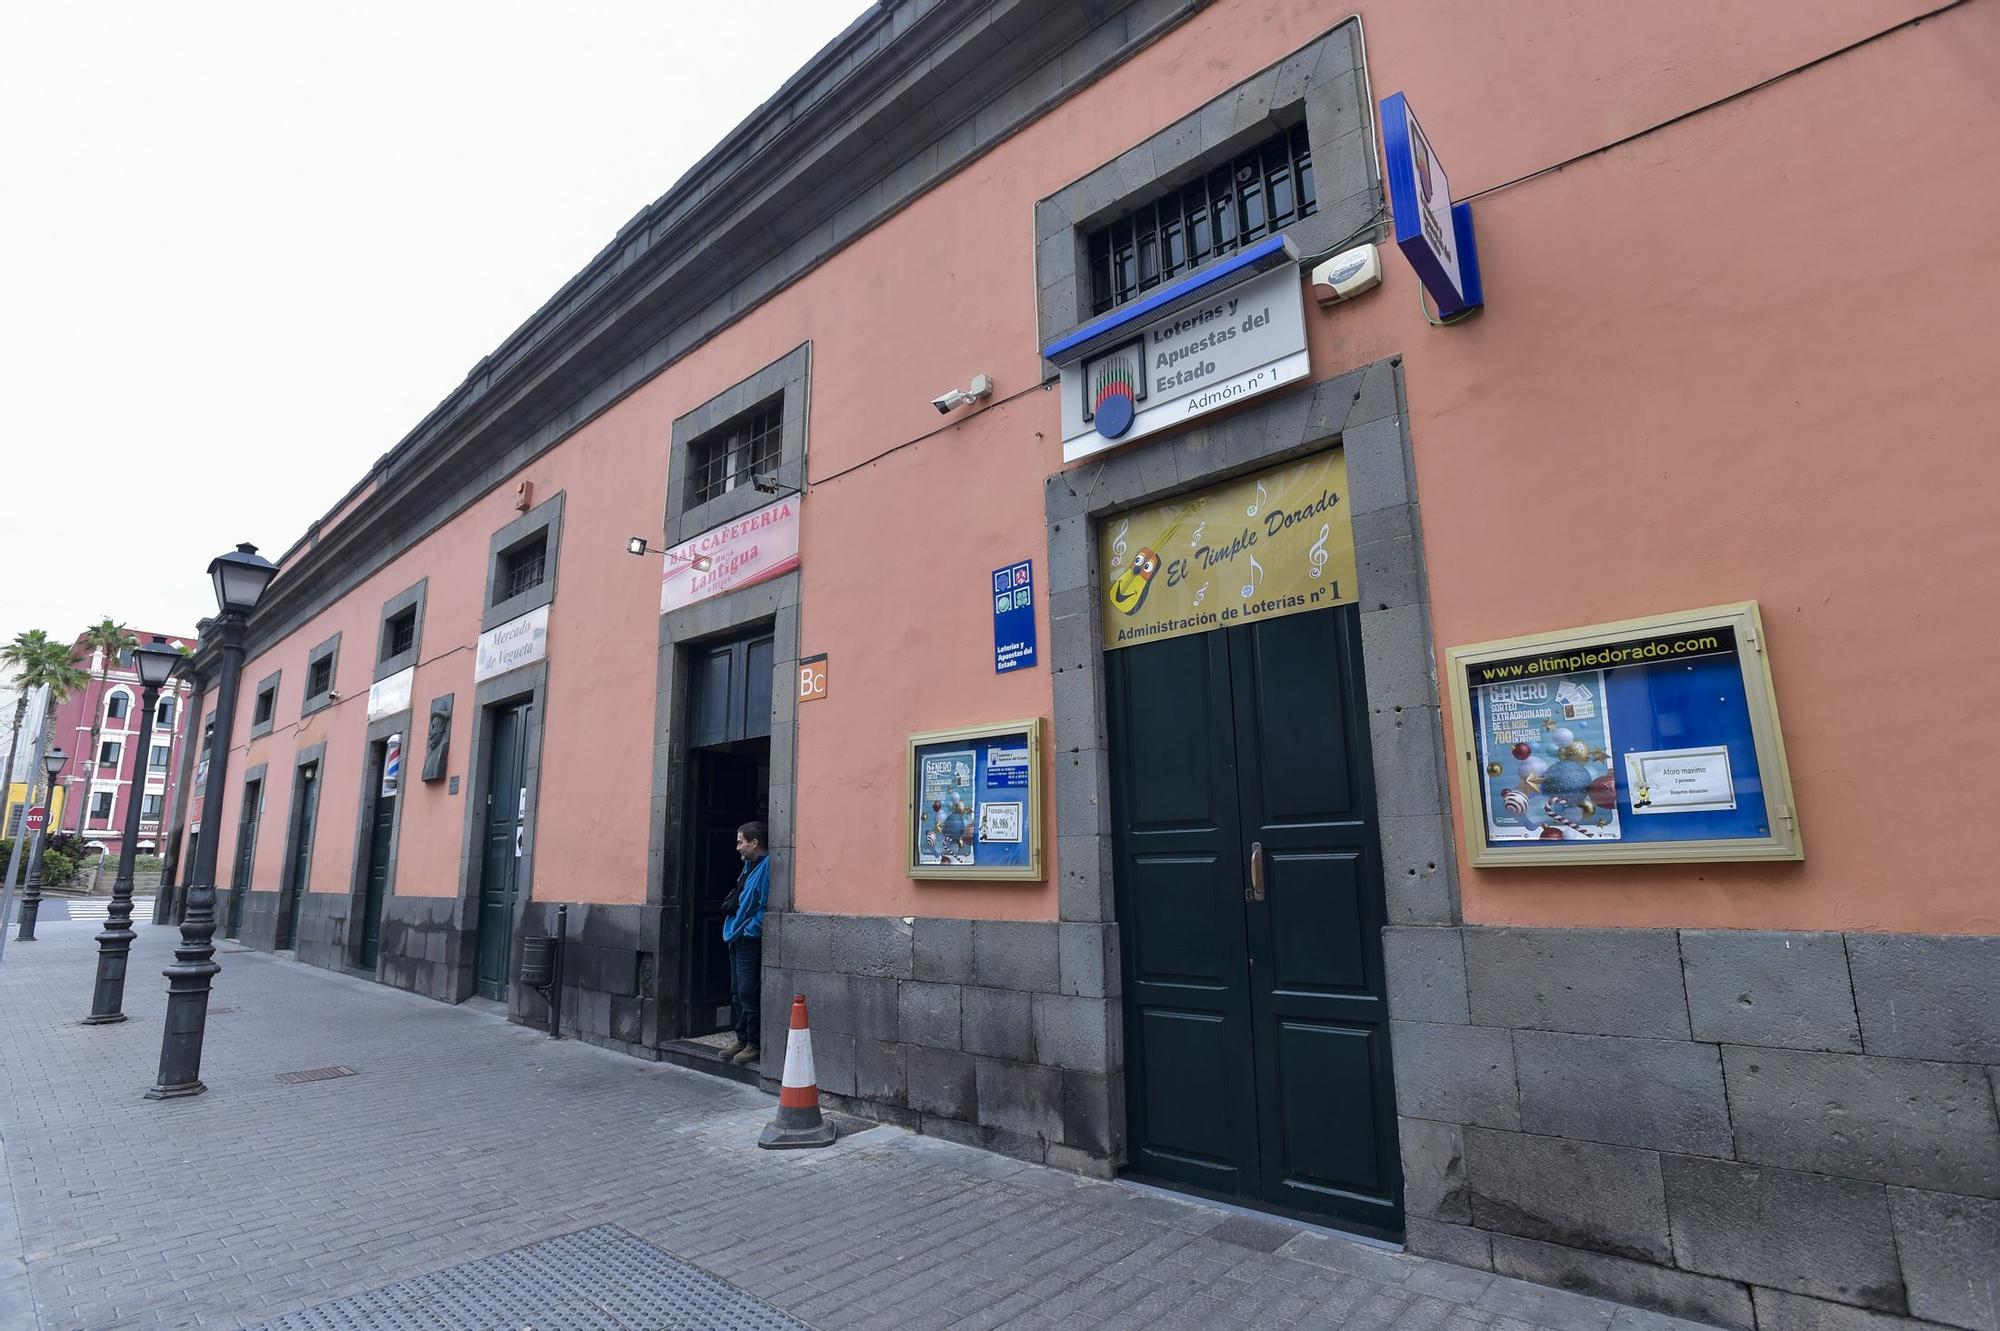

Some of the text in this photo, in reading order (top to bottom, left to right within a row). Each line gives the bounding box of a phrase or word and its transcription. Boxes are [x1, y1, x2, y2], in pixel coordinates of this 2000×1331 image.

[1154, 298, 1239, 344] Loterías y
[1155, 308, 1270, 369] Apuestas del
[1156, 361, 1216, 393] Estado
[1270, 368, 1278, 380] 1
[670, 504, 791, 566] BAR CAFETERIA
[1167, 489, 1340, 587] El Timple Dorado
[691, 545, 758, 594] Lantigua
[1117, 612, 1217, 642] Administración
[1222, 607, 1238, 621] de
[1243, 593, 1305, 616] Loterías
[1329, 580, 1342, 600] 1
[493, 620, 531, 645] Mercado
[485, 643, 533, 669] de Vegueta
[997, 659, 1017, 669] Estado
[998, 646, 1033, 661] Apuestas del
[1482, 635, 1718, 680] www.eltimpledorado.com
[1501, 682, 1548, 701] ENERO
[1490, 703, 1518, 713] SORTEO
[1491, 708, 1552, 722] EXTRAORDINARIO
[1492, 721, 1502, 731] DE
[1502, 721, 1511, 730] EL
[1493, 730, 1511, 744] 700
